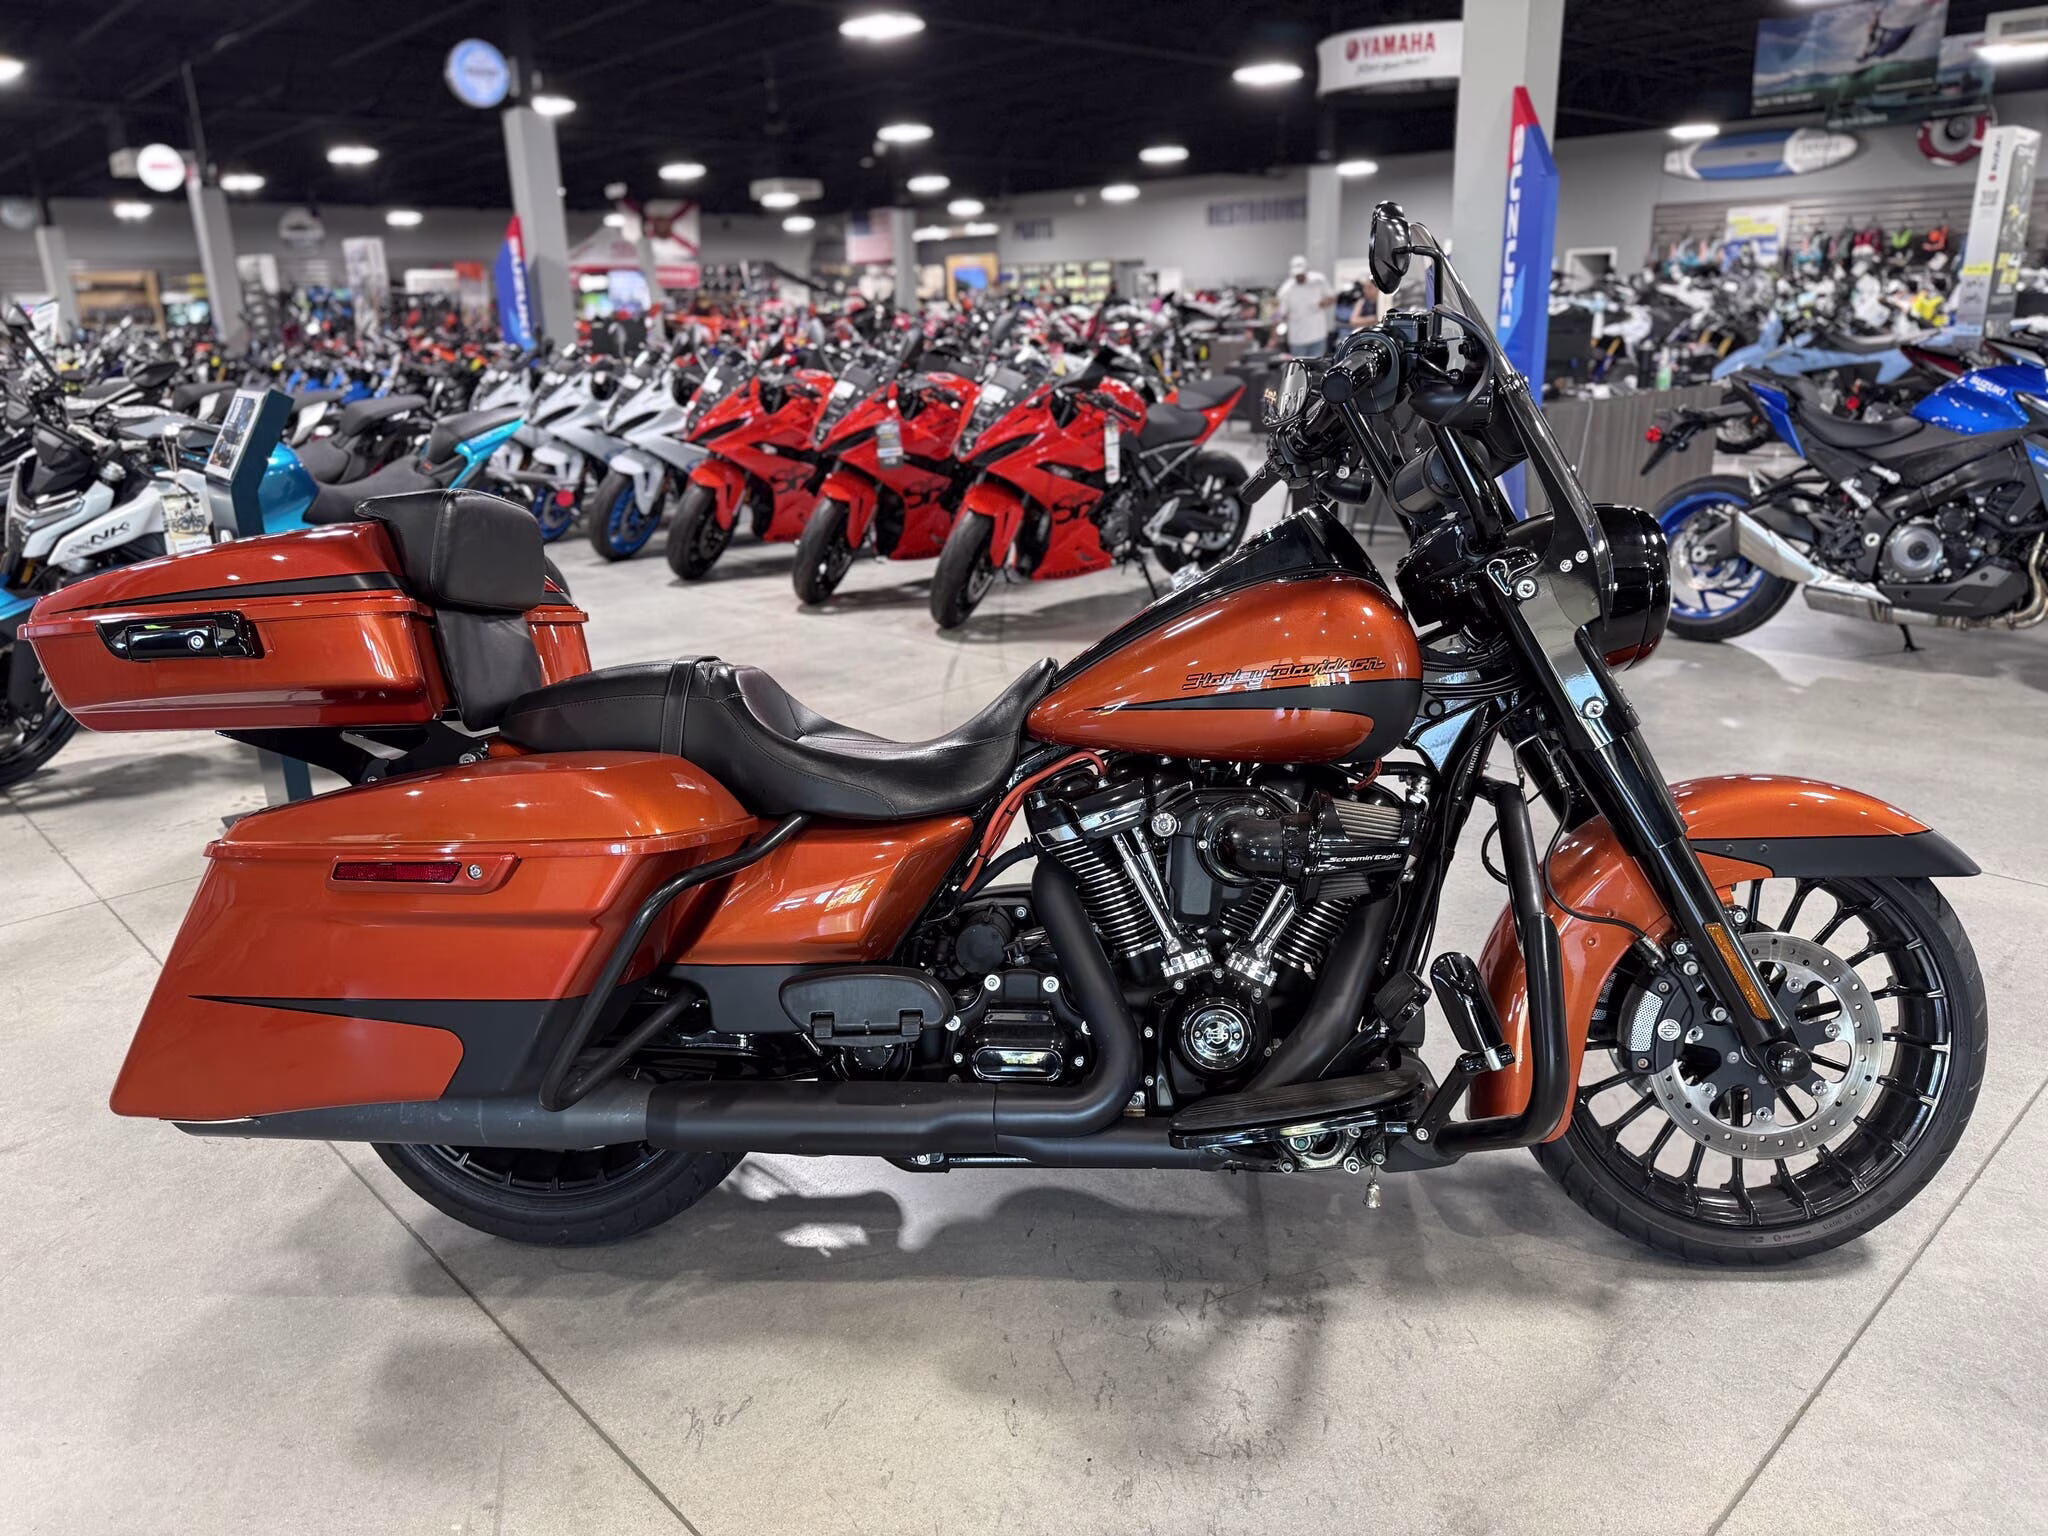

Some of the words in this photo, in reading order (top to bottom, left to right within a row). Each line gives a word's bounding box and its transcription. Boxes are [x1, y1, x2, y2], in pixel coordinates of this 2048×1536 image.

[1362, 31, 1436, 58] YAMAHA
[1500, 124, 1526, 328] SUZUKI
[1969, 375, 2007, 397] SUZUKI
[1182, 656, 1386, 691] Harley-Davidson
[1325, 854, 1375, 863] Screamin'
[1374, 852, 1401, 861] Eagle
